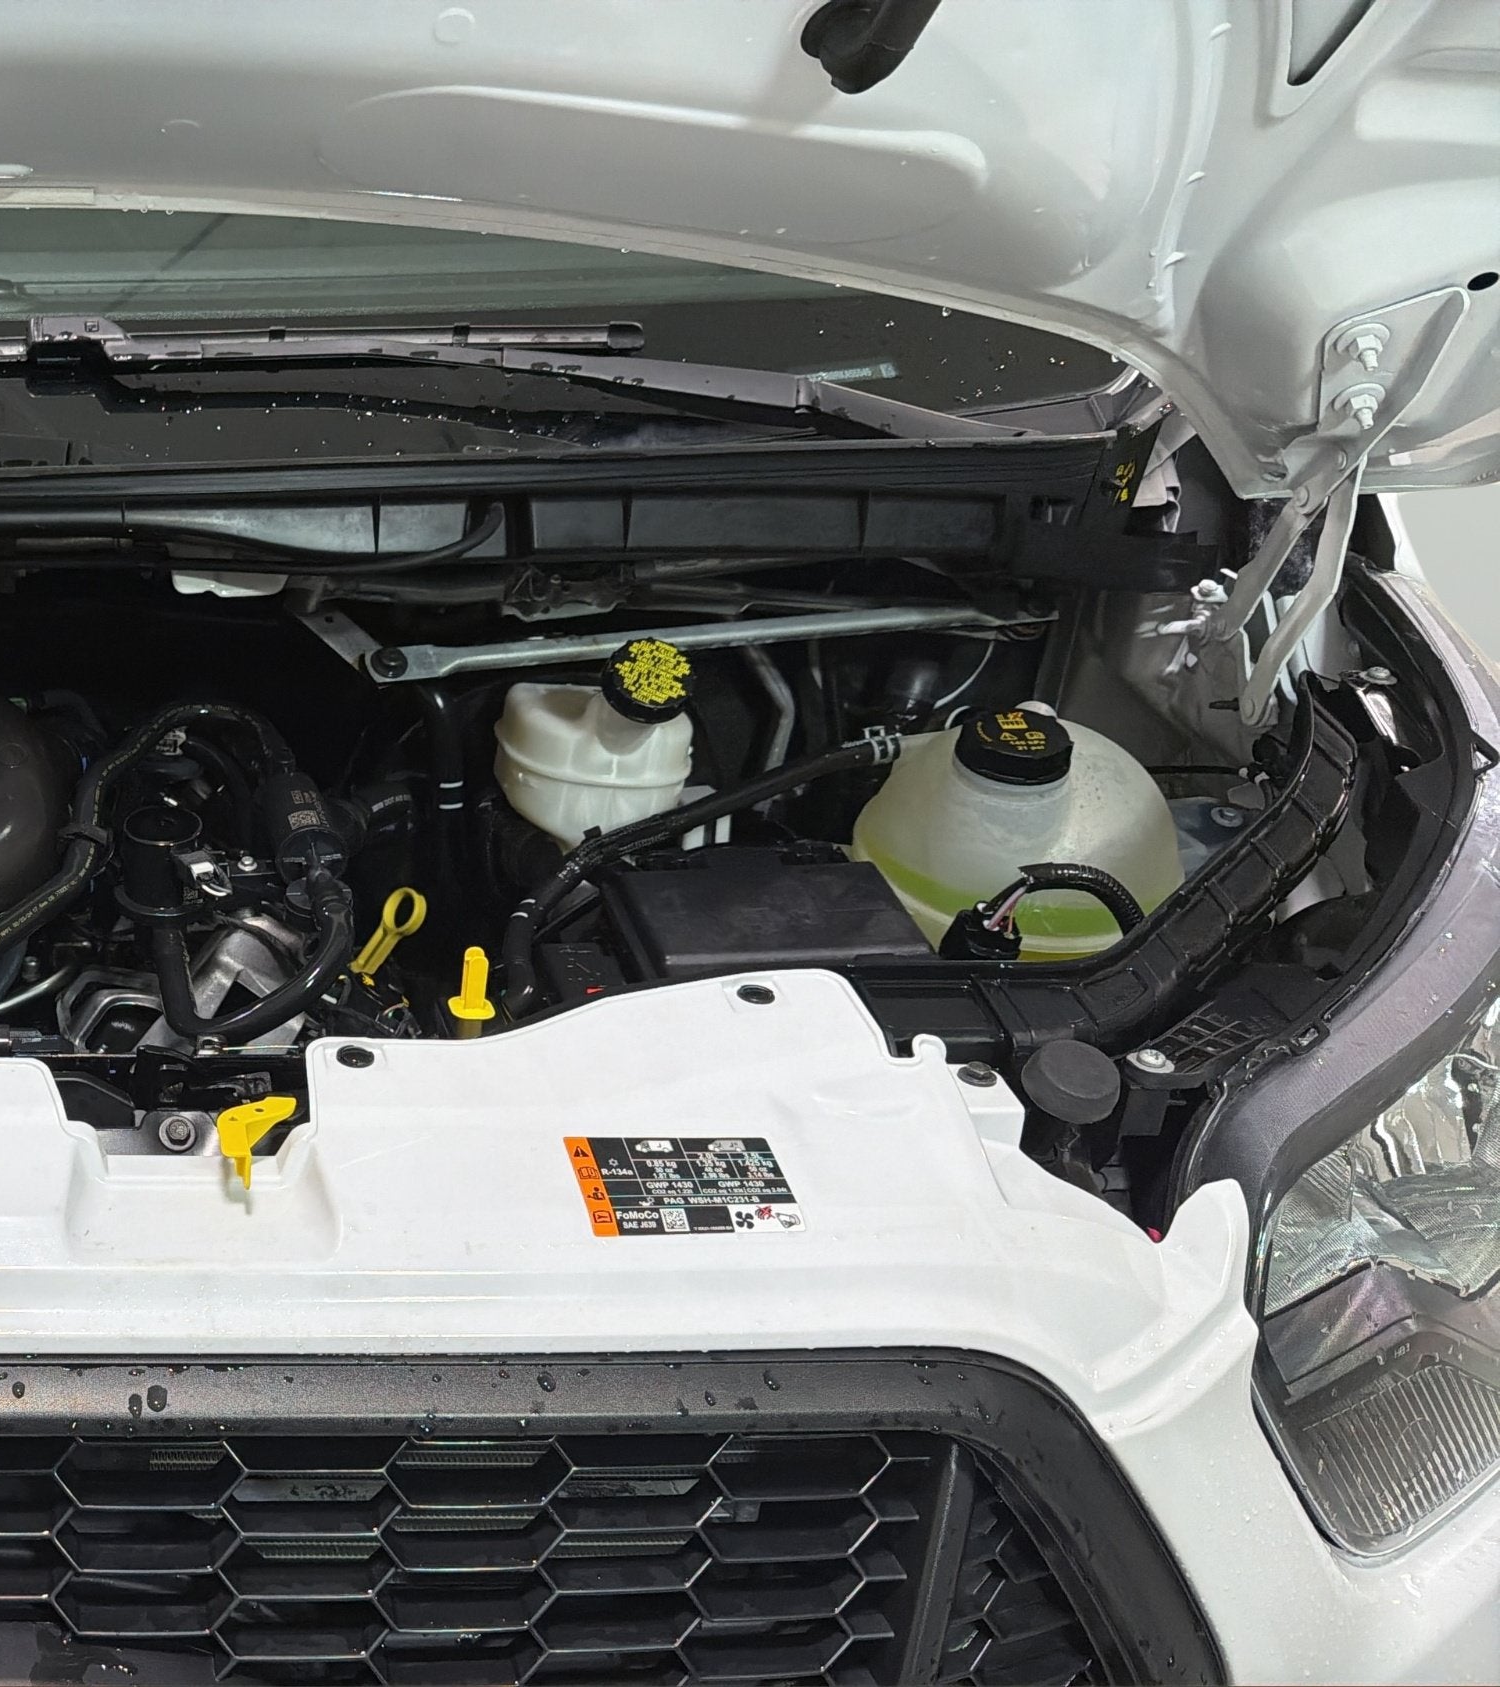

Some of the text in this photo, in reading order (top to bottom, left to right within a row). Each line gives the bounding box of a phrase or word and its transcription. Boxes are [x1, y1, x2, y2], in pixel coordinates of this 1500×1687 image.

[601, 1168, 634, 1176] R-134a
[646, 1181, 669, 1189] GWP
[616, 1211, 659, 1220] FoMoCo
